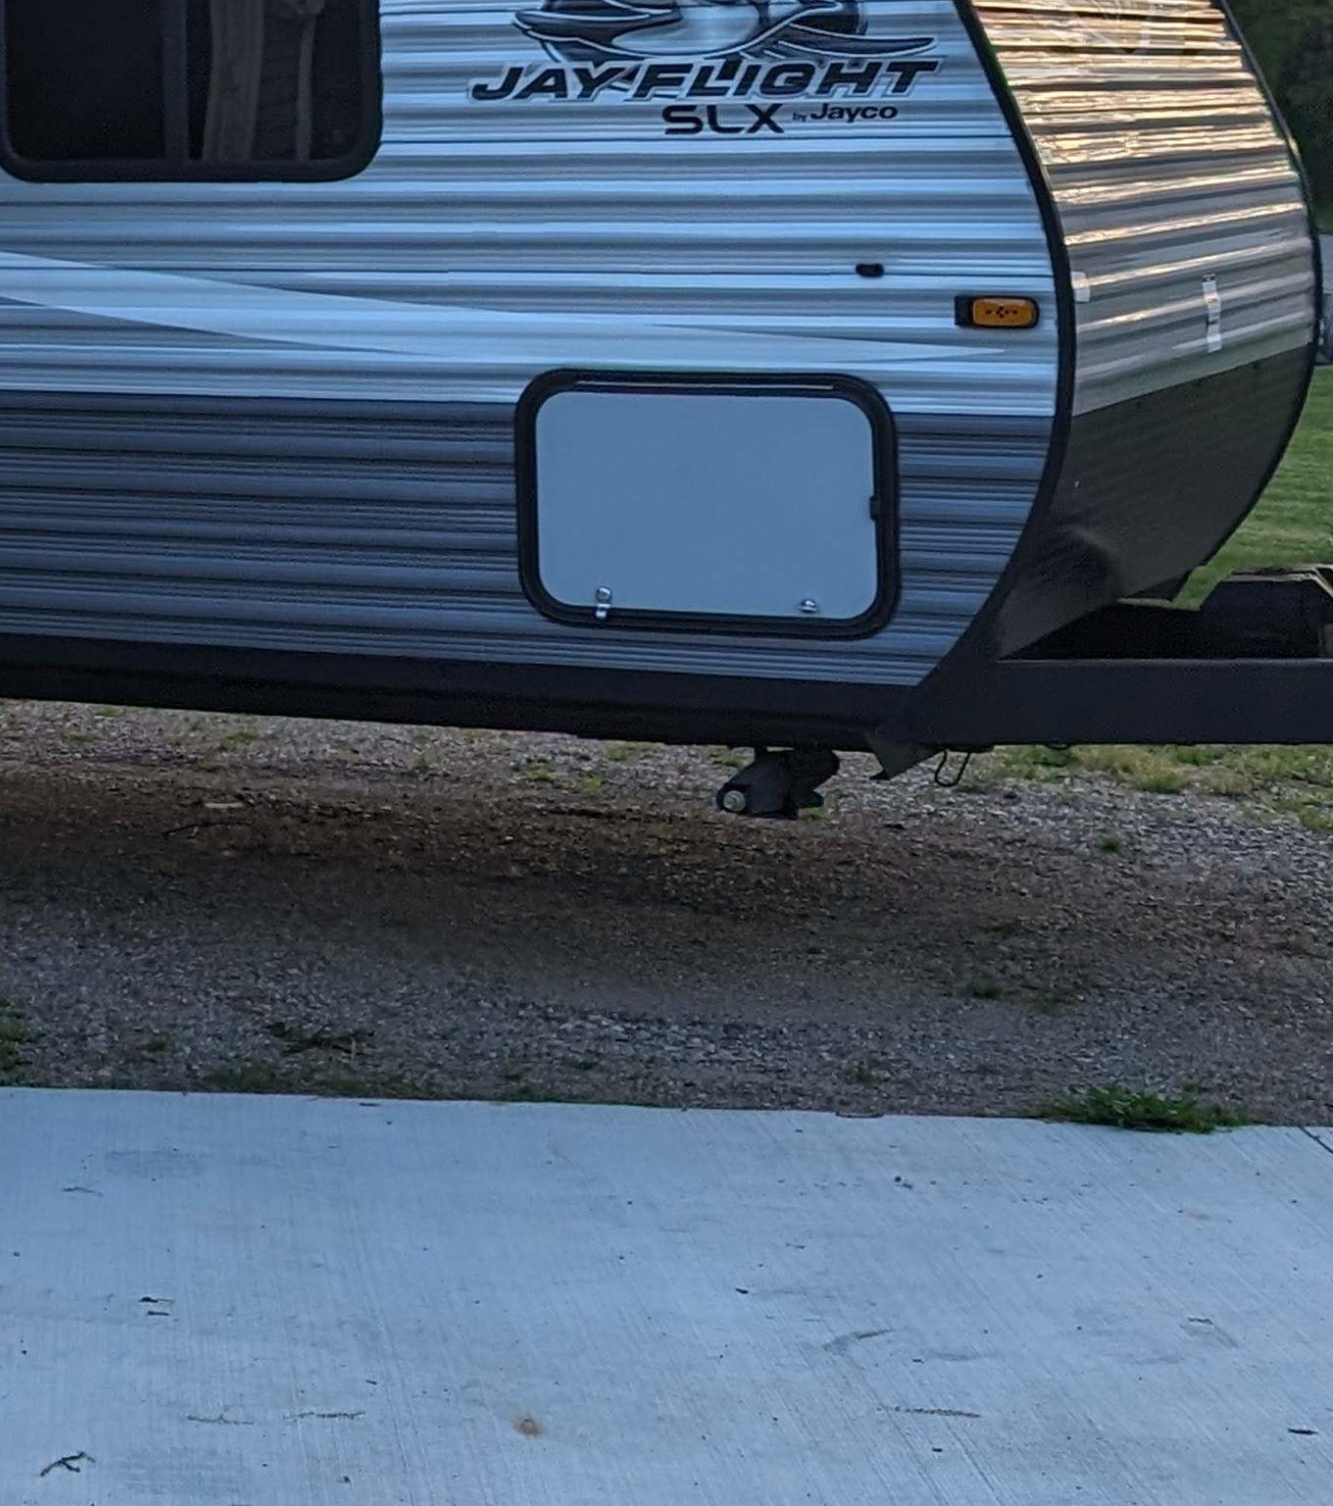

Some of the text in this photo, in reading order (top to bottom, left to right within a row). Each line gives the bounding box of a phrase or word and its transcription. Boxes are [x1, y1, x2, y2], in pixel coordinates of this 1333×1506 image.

[470, 60, 940, 101] JAY FLIGHT
[661, 103, 784, 135] SLX
[810, 102, 899, 124] Jayco
